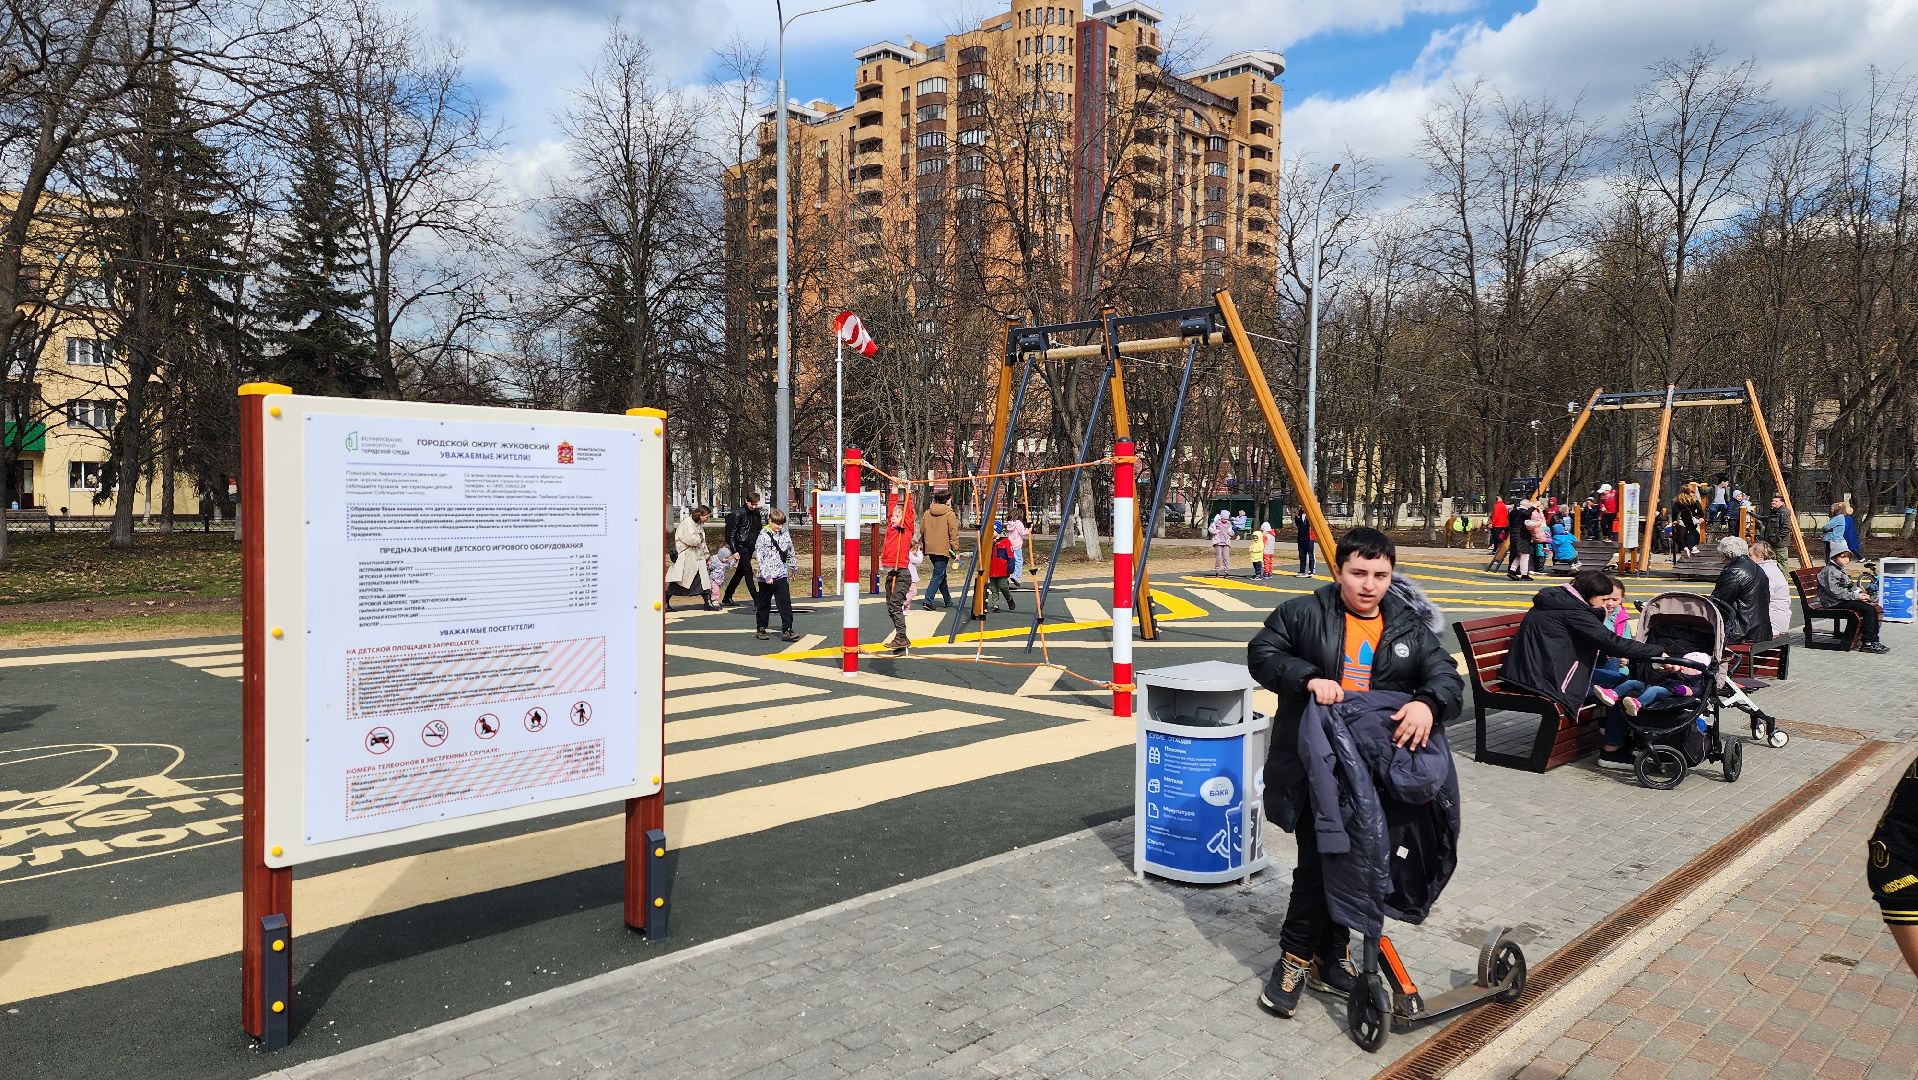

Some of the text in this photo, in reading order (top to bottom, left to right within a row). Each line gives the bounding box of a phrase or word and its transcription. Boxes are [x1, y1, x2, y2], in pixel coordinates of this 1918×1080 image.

[417, 439, 550, 450] ГОРОДСКОЙ ОКРУГ ЖУКОВСКИЙ
[440, 451, 531, 461] УВАЖАЕМЫЕ ЖИТЕЛИ!
[380, 546, 452, 554] ПРЕДНАЗНАЧЕНИЕ
[440, 623, 535, 636] УВАЖАЕМЫЕ ПОСЕТИТЕЛИ!
[358, 647, 391, 655] ДЕТСКОЙ
[392, 643, 431, 651] ПЛОЩАДКЕ
[1168, 736, 1191, 745] ОТХОДЫ
[1164, 746, 1187, 754] Пластик
[346, 766, 376, 774] НОМЕРА
[378, 760, 419, 769] ТЕЛЕФОНОВ
[426, 752, 468, 762] ЭКСТРЕННЫХ
[470, 748, 500, 757] СЛУЧАЯХ:
[1164, 776, 1184, 785] Металл
[1209, 789, 1229, 797] БАКА
[1163, 806, 1195, 817] Макулатура
[1147, 838, 1165, 847] Стекло
[1882, 874, 1918, 895] MOSCHINO
